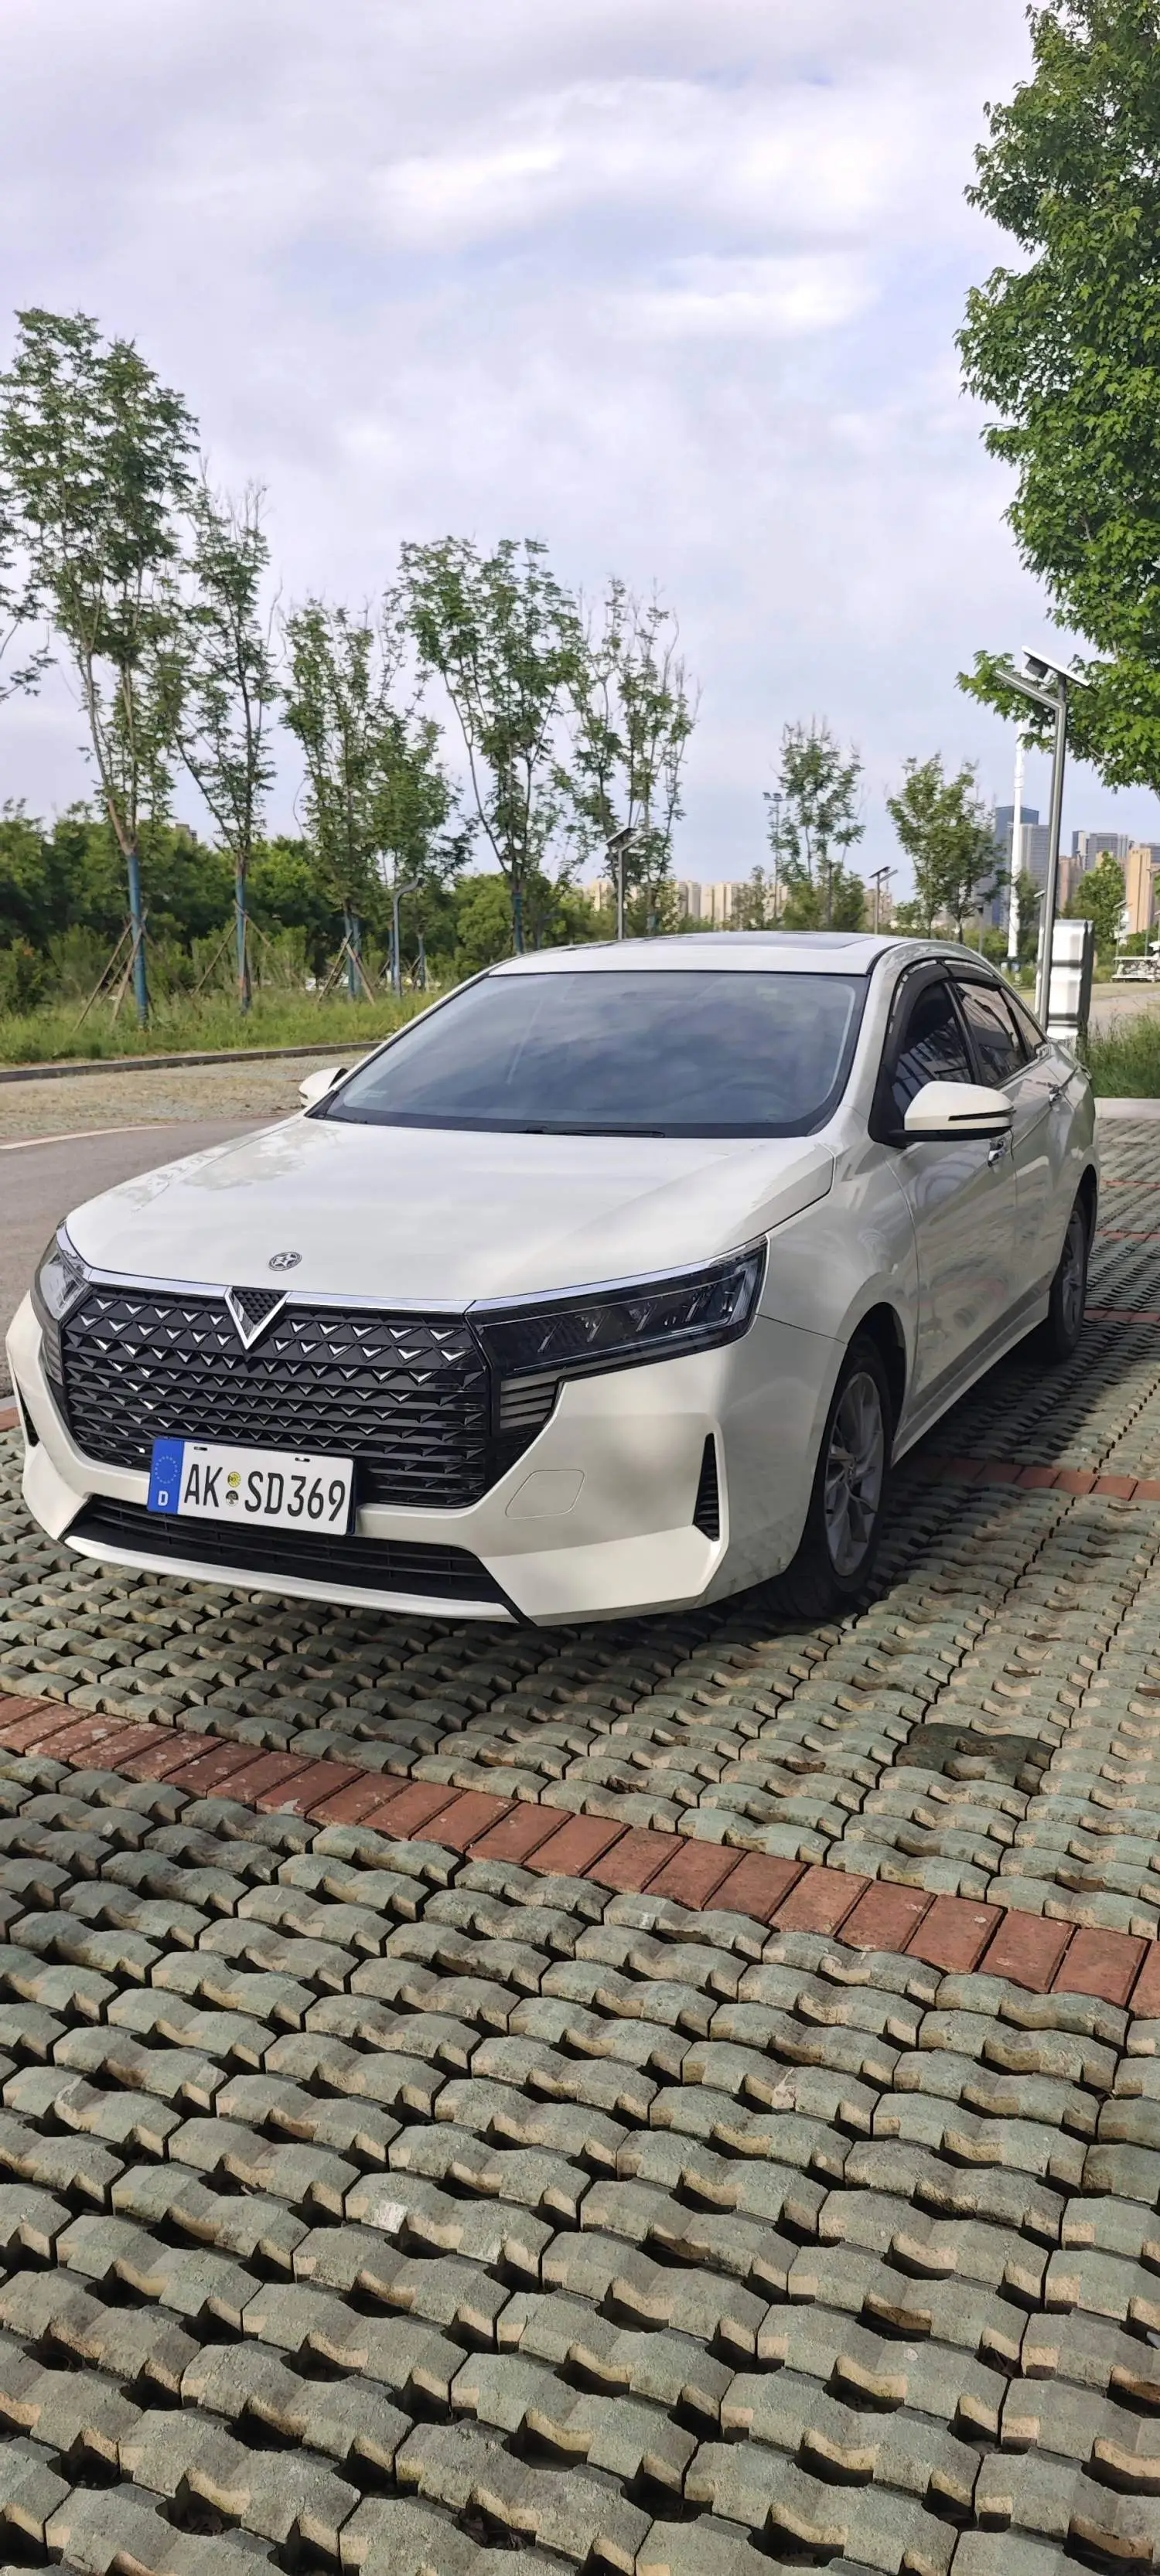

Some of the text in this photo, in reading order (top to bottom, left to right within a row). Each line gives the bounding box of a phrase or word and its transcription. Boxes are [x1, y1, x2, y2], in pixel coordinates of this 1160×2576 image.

[158, 1491, 169, 1506] D
[184, 1463, 346, 1521] AK SD369
